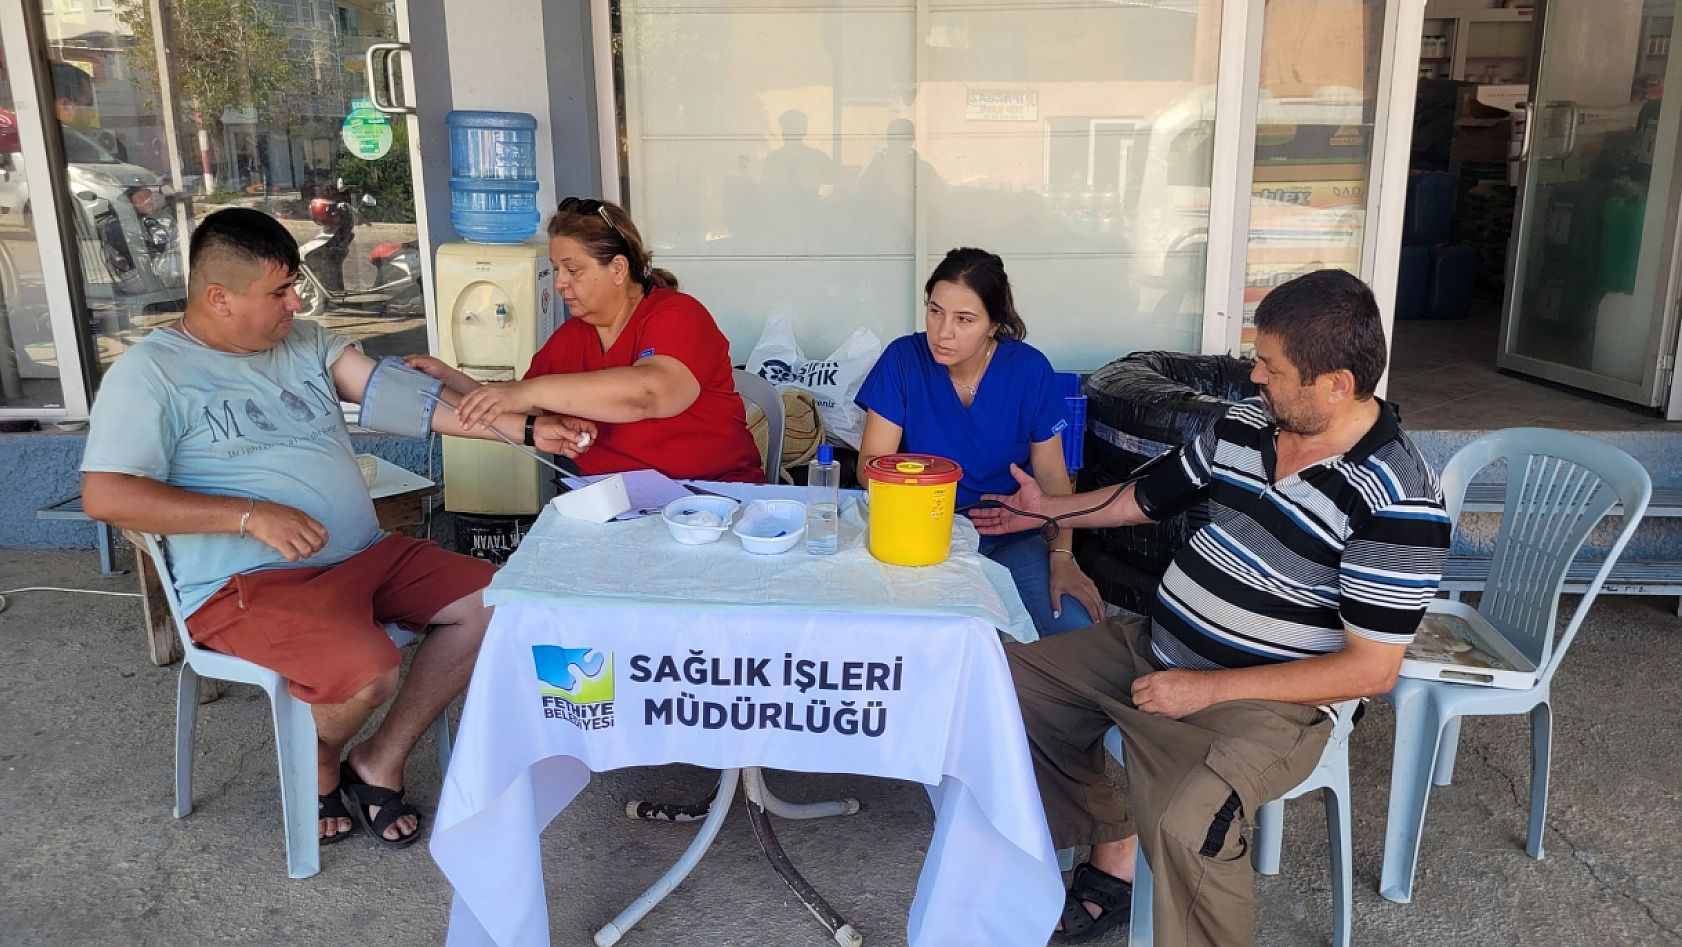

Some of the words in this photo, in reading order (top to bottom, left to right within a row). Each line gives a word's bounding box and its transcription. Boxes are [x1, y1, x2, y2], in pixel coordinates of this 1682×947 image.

[629, 649, 772, 687] SAĞLIK
[782, 652, 903, 694] İŞLERİ
[644, 691, 888, 738] MÜDÜRLÜĞÜ
